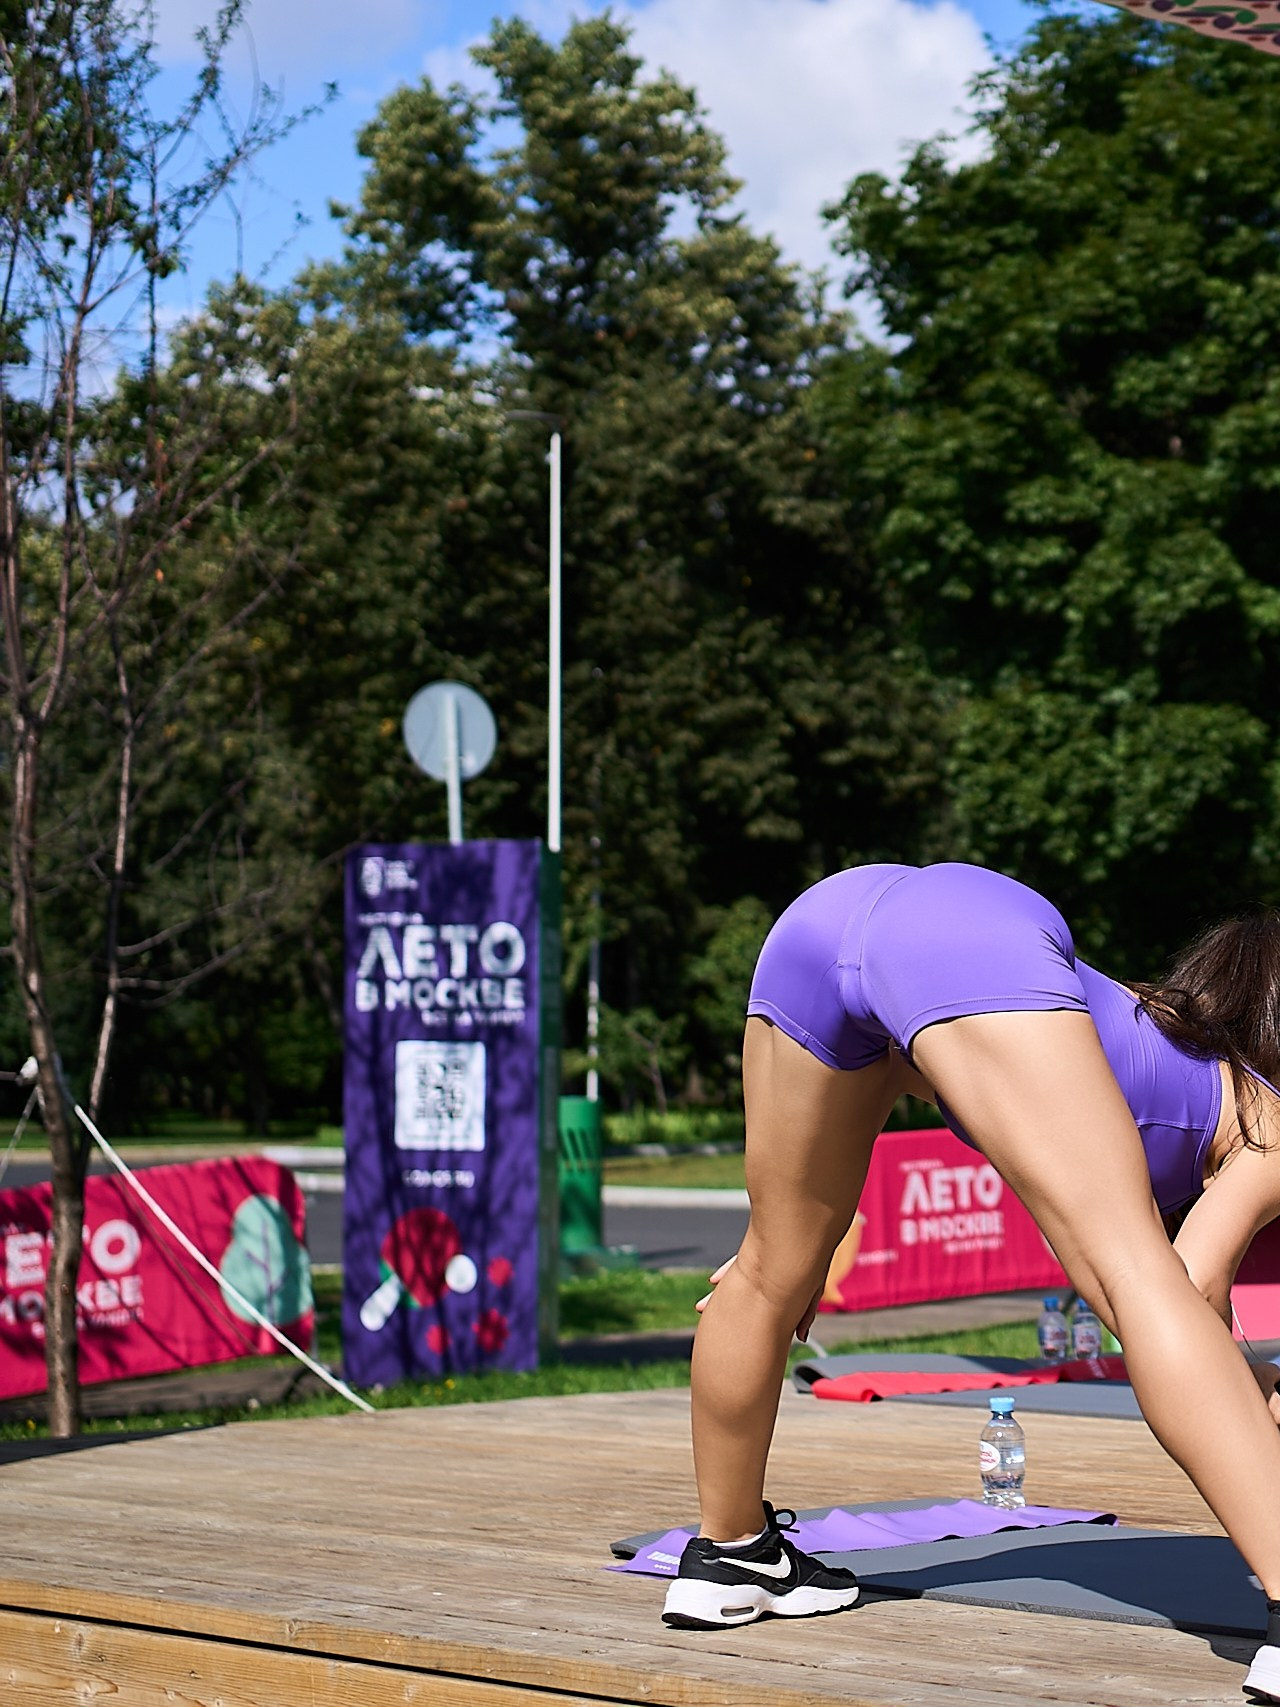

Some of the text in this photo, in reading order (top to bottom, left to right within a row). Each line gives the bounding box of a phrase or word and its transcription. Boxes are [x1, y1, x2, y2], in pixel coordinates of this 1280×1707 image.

[356, 921, 526, 979] ЛЕТО
[355, 978, 526, 1012] В МОСКВЕ
[901, 1164, 1003, 1215] ЛЕТО
